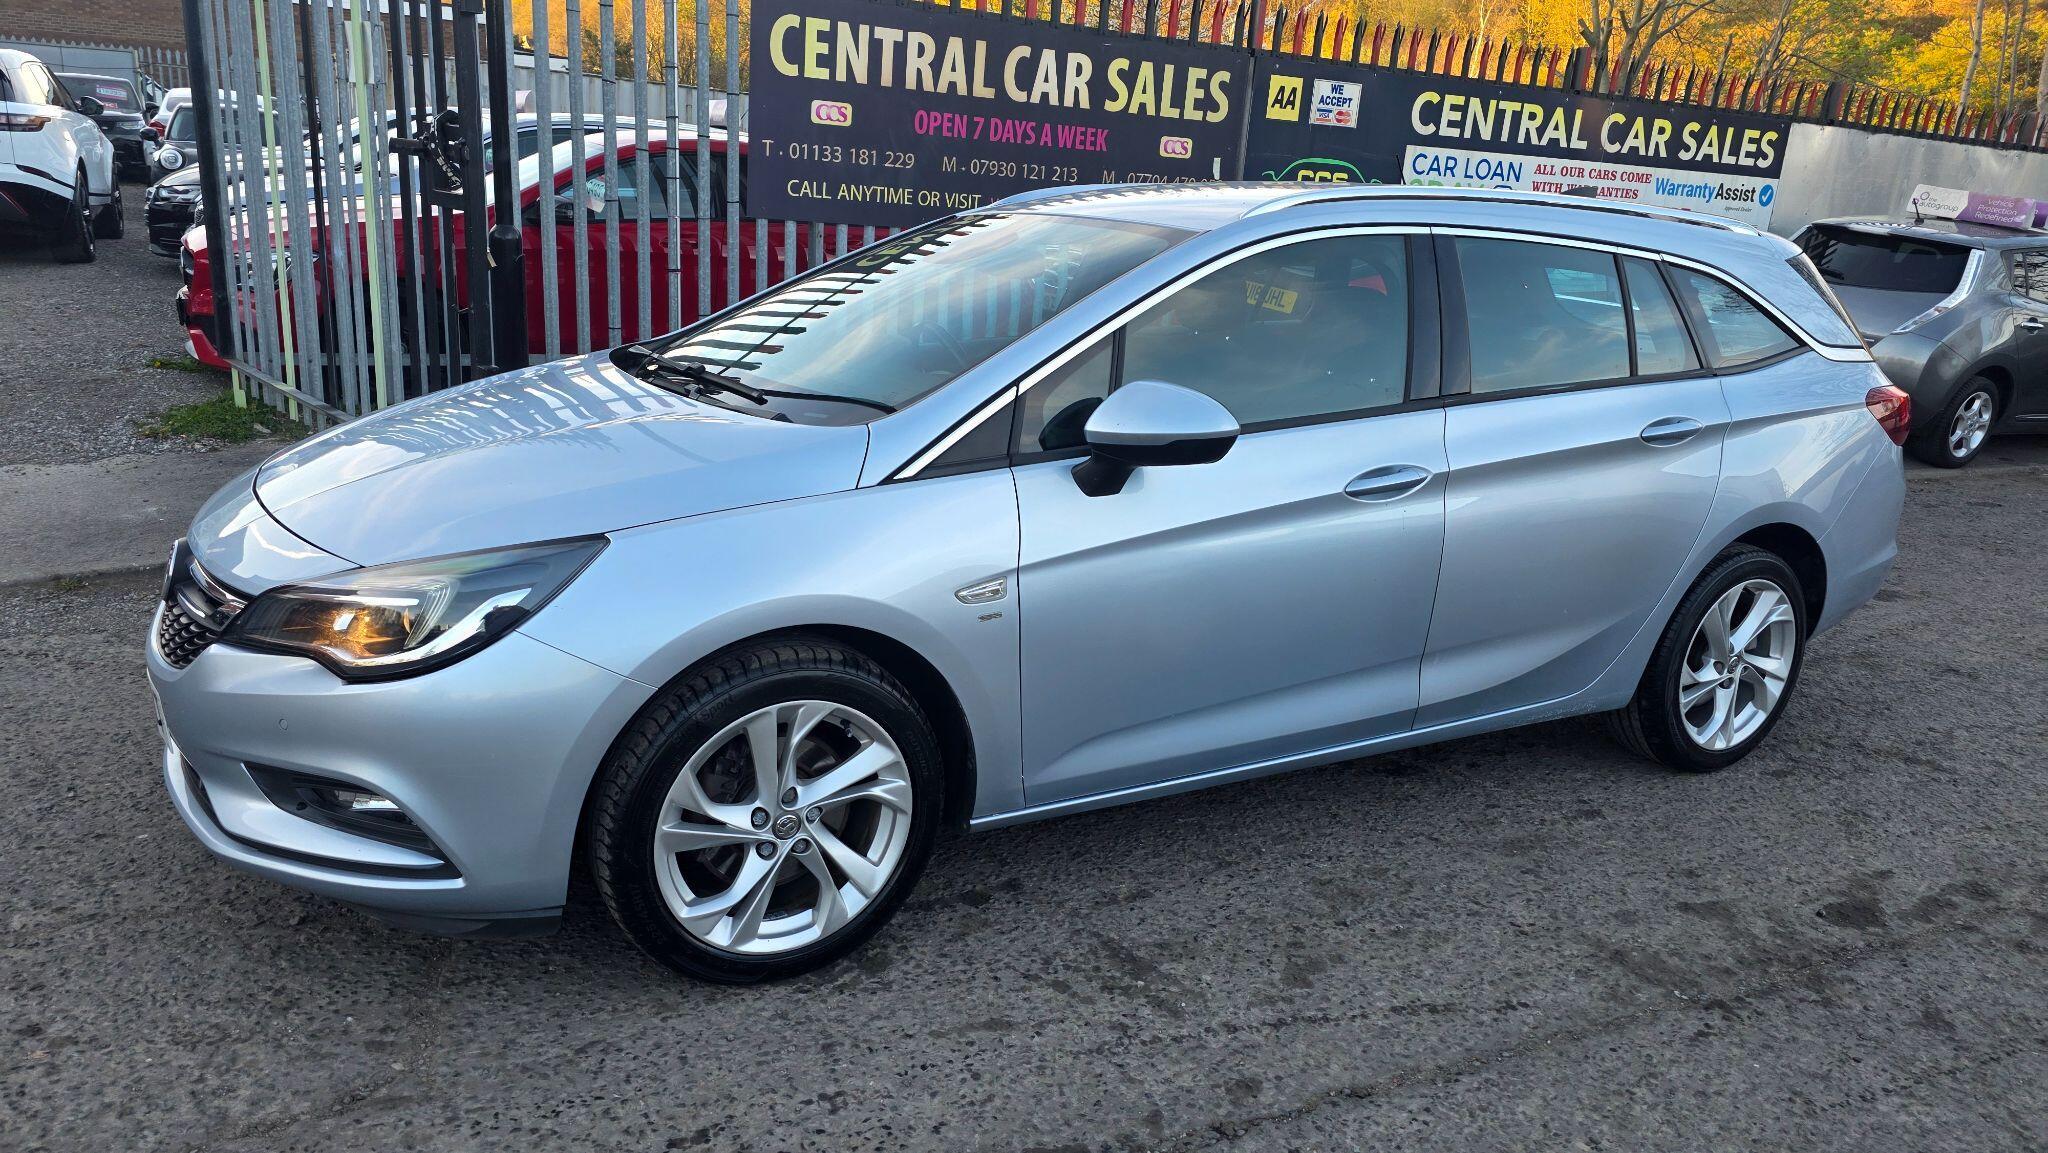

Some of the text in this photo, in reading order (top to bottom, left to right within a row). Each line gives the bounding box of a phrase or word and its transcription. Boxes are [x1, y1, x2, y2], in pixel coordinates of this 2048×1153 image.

[769, 13, 1232, 123] CENTRAL CAR SALES
[1270, 85, 1298, 111] AA
[1318, 95, 1353, 108] ACCEPT
[1330, 83, 1345, 96] WE
[914, 109, 1109, 152] OPEN 7 DAYS A WEEK
[1410, 90, 1779, 168] CENTRAL CAR SALES
[789, 142, 842, 163] 01133
[850, 148, 877, 166] 181
[884, 151, 915, 169] 229
[1411, 152, 1523, 183] CAR LOAN
[970, 158, 1017, 178] 07930
[1022, 163, 1046, 180] 121
[1051, 166, 1078, 183] 213
[1534, 163, 1653, 184] ALL OUR CARS COME
[787, 179, 832, 200] CALL
[837, 183, 914, 205] ANYTIME
[917, 190, 940, 207] OR
[944, 192, 982, 209] VISIT
[1532, 180, 1639, 200] WITH WANTIES
[1977, 204, 2018, 216] Protection
